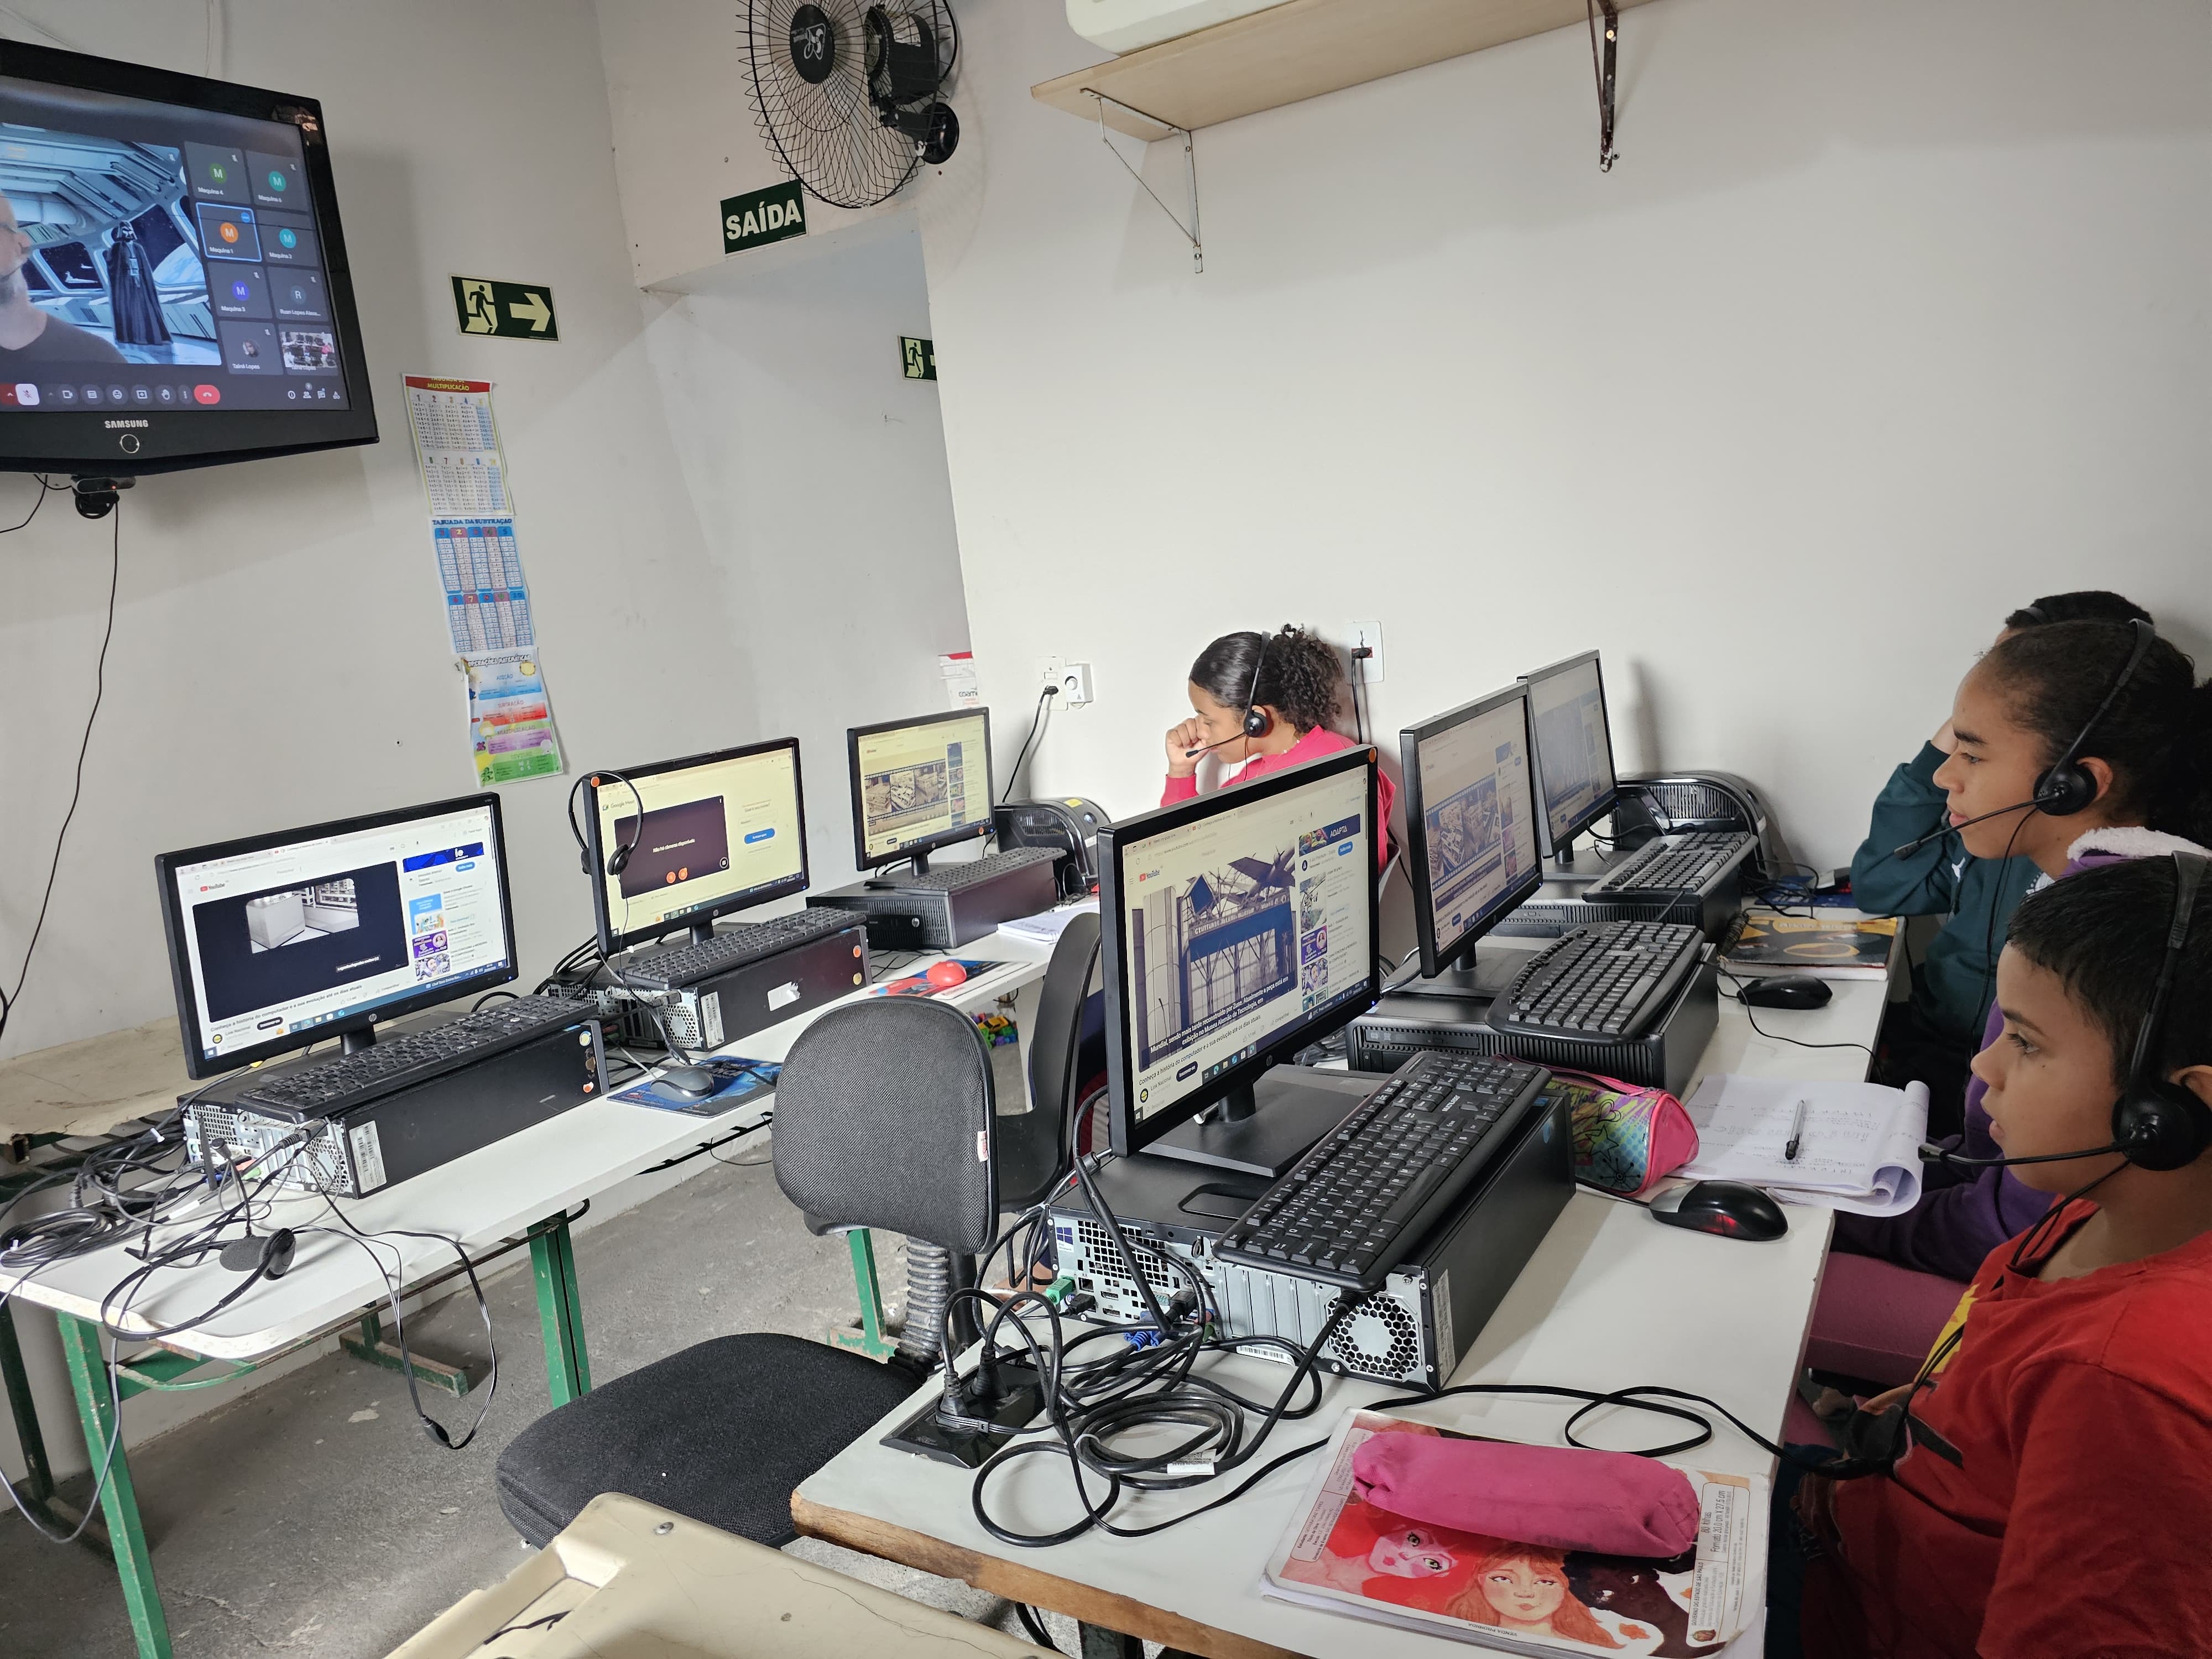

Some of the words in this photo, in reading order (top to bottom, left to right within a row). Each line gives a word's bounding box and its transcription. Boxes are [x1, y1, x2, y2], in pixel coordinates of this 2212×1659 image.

[213, 168, 222, 178] M
[273, 177, 282, 186] M
[726, 199, 802, 241] SAÍDA
[225, 228, 234, 237] M
[283, 234, 293, 243] M
[236, 286, 246, 296] M
[295, 291, 302, 300] R
[105, 419, 149, 429] SAMSUNG
[1330, 825, 1347, 838] ADAPTA
[1146, 869, 1160, 879] YouTube
[211, 1022, 231, 1032] Conheça
[236, 1016, 254, 1025] história
[262, 1005, 289, 1018] computador
[306, 995, 326, 1004] evolução
[1150, 1039, 1168, 1053] Mundial,
[1168, 1032, 1181, 1044] sendo
[1181, 1027, 1191, 1037] mais
[1191, 1021, 1202, 1032] tarde
[1202, 1008, 1226, 1027] reconstruído
[1244, 989, 1263, 1004] Atualmente
[1266, 983, 1275, 993] peça
[1275, 979, 1283, 988] está
[1182, 1030, 1198, 1046] exibição
[1204, 1021, 1217, 1032] Museu
[1218, 1013, 1232, 1025] Alemão
[1139, 1072, 1156, 1086] Conheça
[1160, 1062, 1175, 1073] história
[1181, 1046, 1203, 1063] computador
[1216, 1030, 1232, 1042] evolução
[1250, 1014, 1261, 1025] atuais
[1157, 1075, 1172, 1086] Nacional
[1718, 1490, 1726, 1499] cm
[1702, 1511, 1712, 1525] folhas
[1716, 1514, 1723, 1522] cm
[1710, 1533, 1721, 1552] Formato
[1468, 1623, 1496, 1632] PROIBIDA
[1497, 1629, 1517, 1637] VENDA
